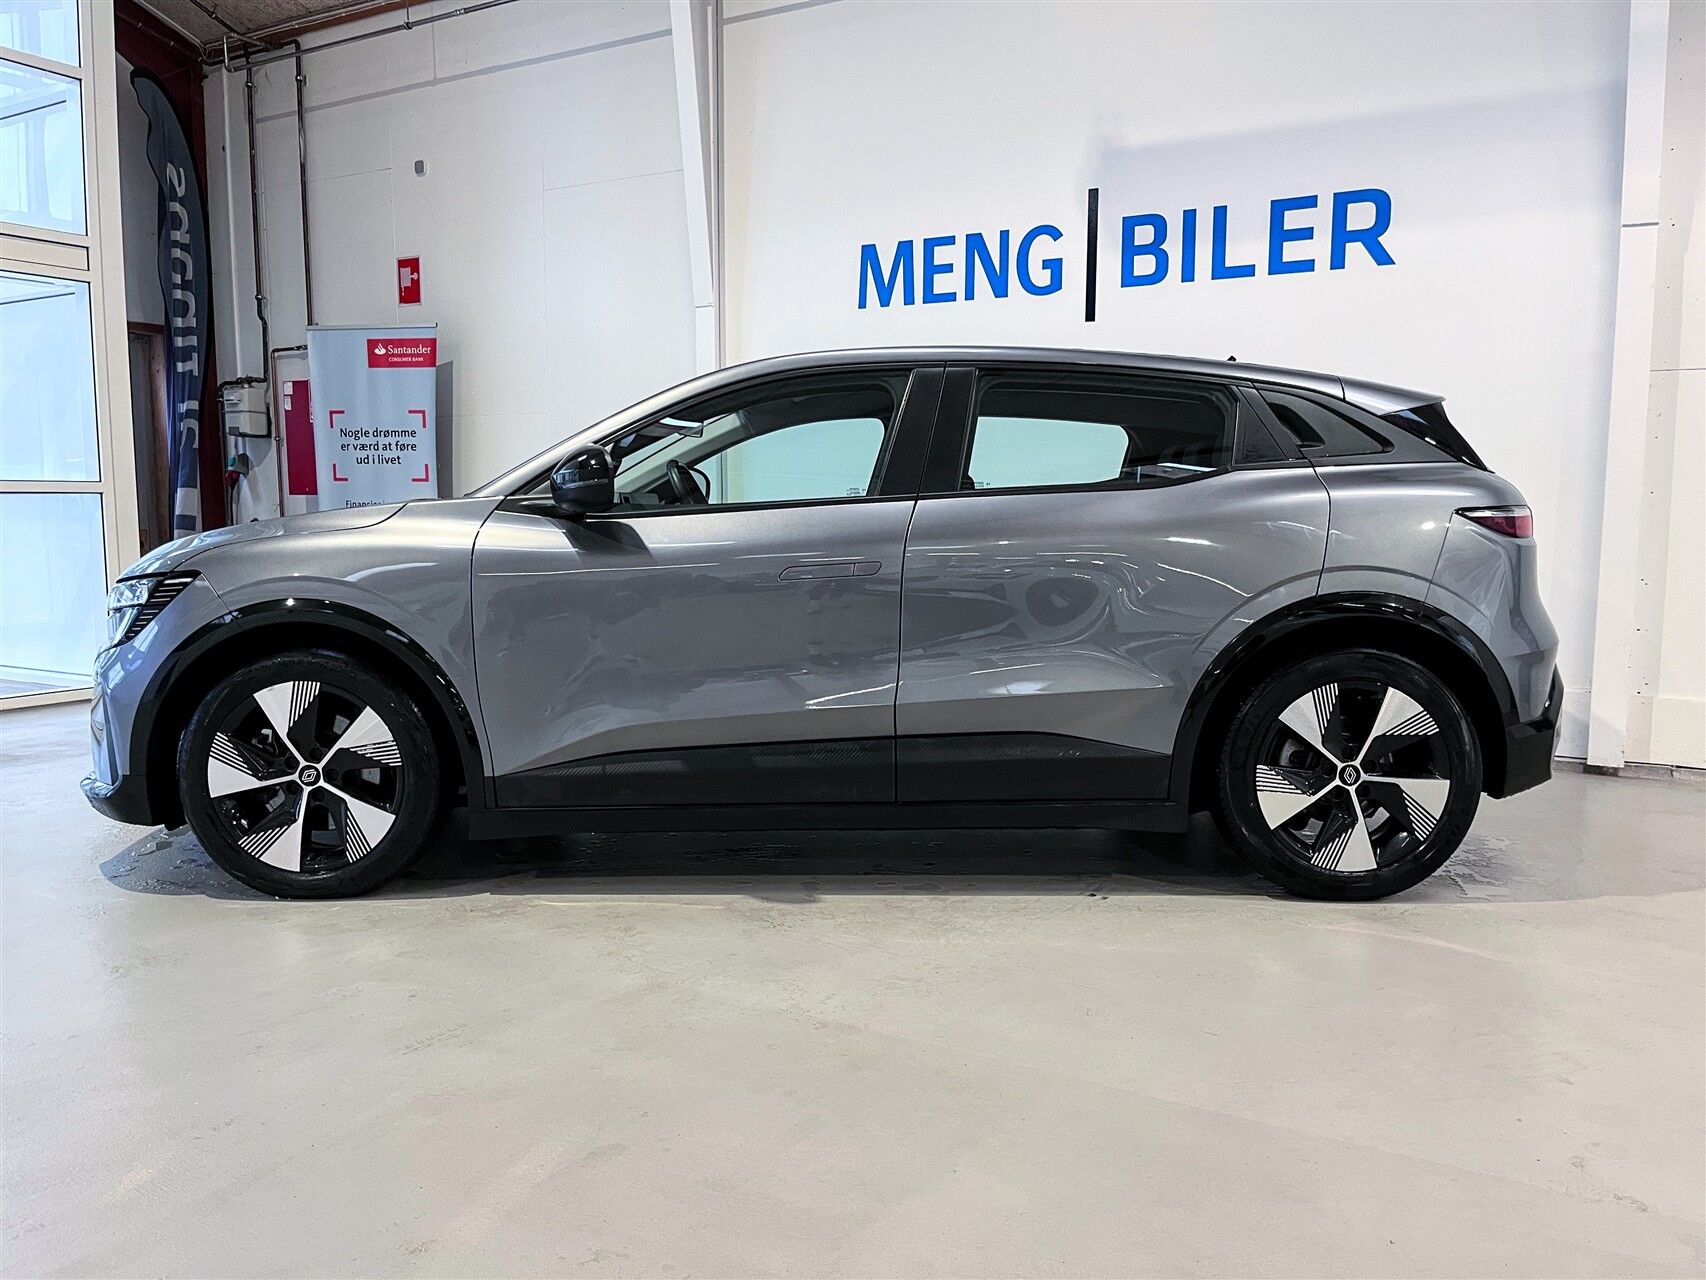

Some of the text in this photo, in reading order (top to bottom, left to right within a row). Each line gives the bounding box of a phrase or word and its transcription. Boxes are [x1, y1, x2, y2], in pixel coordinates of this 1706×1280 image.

[858, 188, 1396, 310] MENG BILER
[387, 343, 432, 355] Santander
[340, 427, 417, 440] Nogle drømme
[340, 440, 417, 452] er værd at føre
[356, 454, 370, 464] ud
[377, 454, 402, 464] livet
